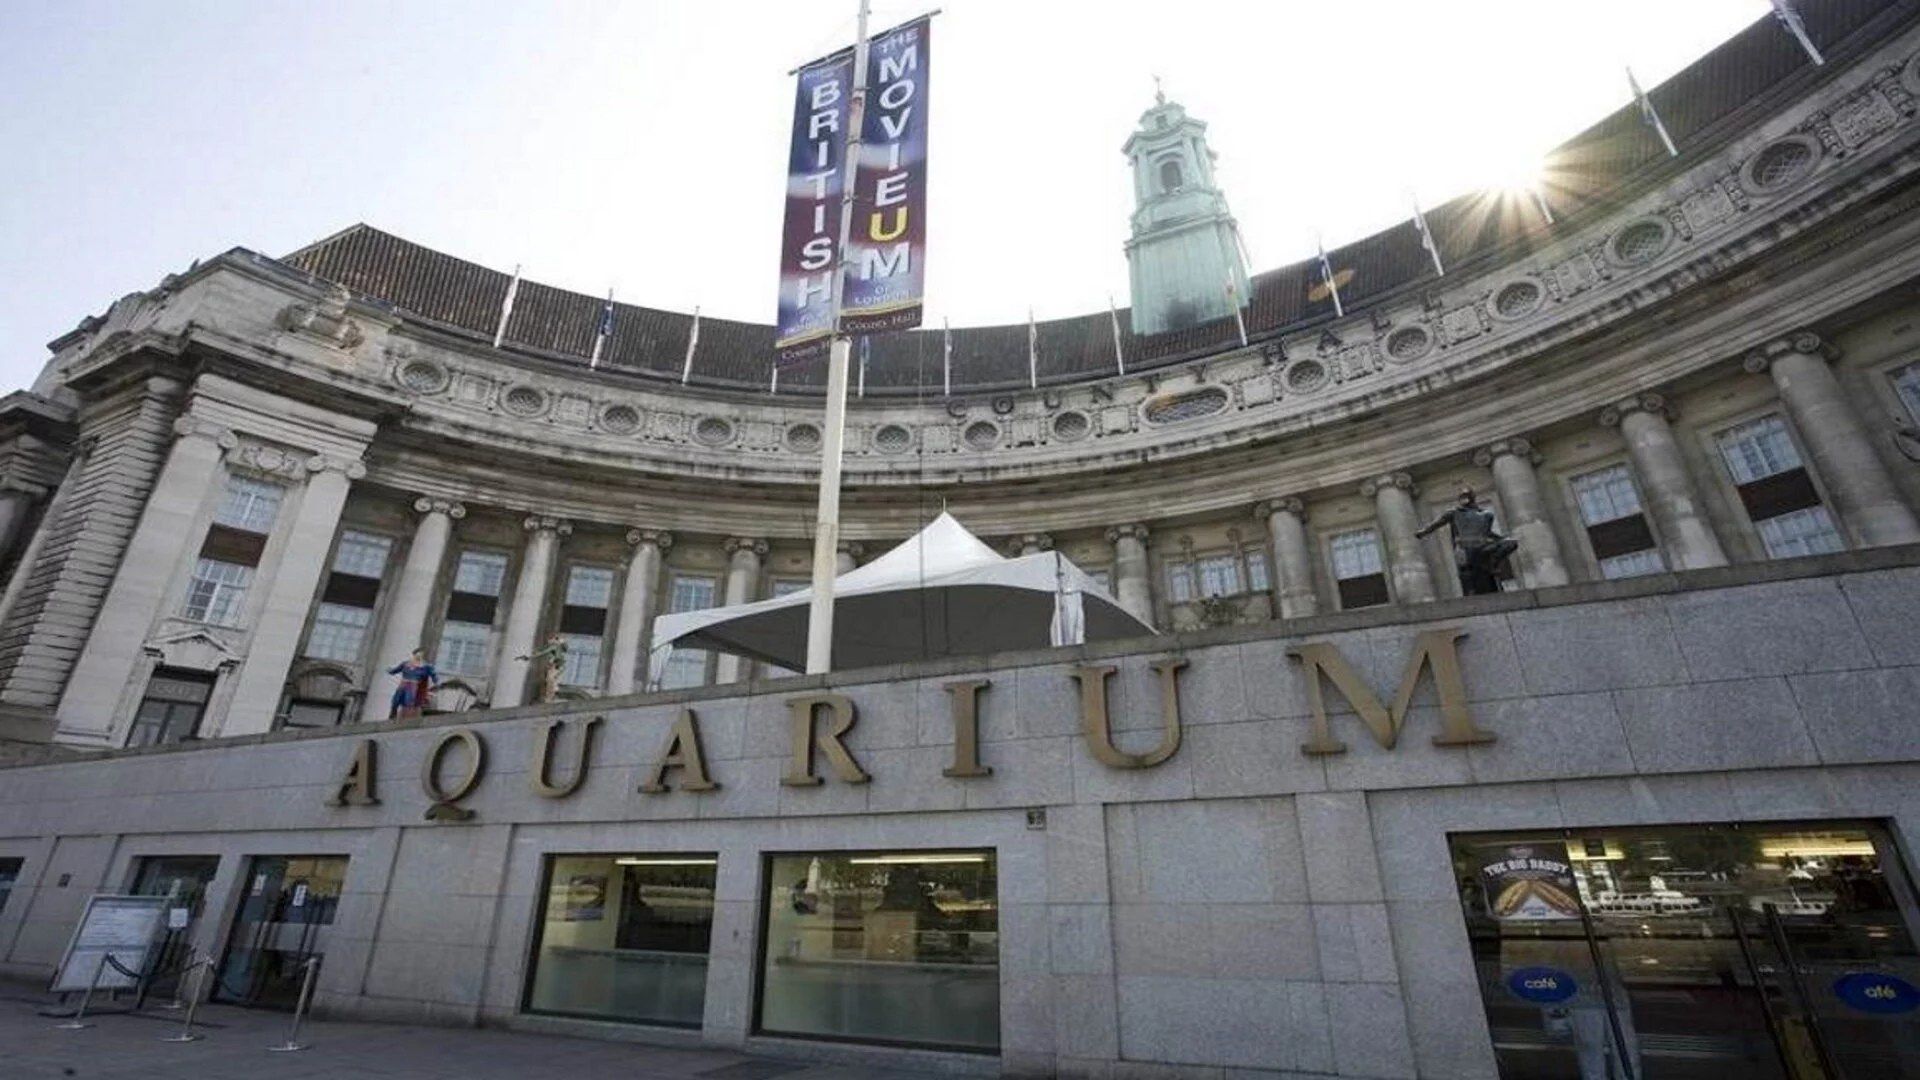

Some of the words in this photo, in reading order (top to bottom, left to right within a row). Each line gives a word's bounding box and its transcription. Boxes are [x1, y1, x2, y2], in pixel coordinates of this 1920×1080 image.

[878, 26, 920, 53] THE
[797, 80, 842, 310] BRITISH
[860, 44, 919, 281] MOVIEUM
[330, 627, 1496, 821] AQUARIUM
[1523, 976, 1558, 990] café
